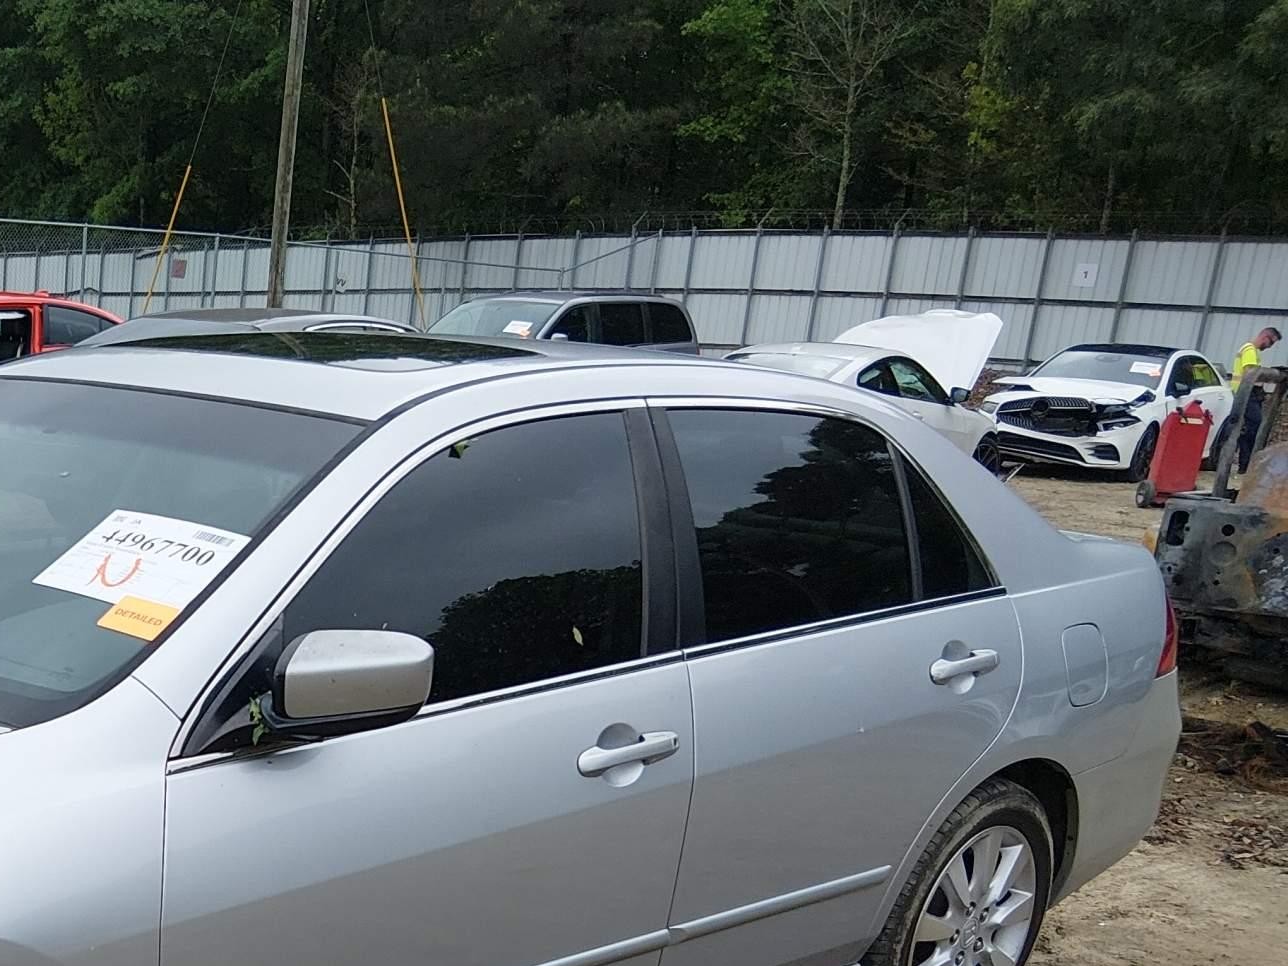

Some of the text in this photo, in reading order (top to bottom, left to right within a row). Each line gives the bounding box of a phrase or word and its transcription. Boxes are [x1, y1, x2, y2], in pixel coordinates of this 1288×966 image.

[1083, 271, 1089, 279] 1
[101, 529, 215, 566] 44967700
[114, 608, 163, 626] DETAILED
